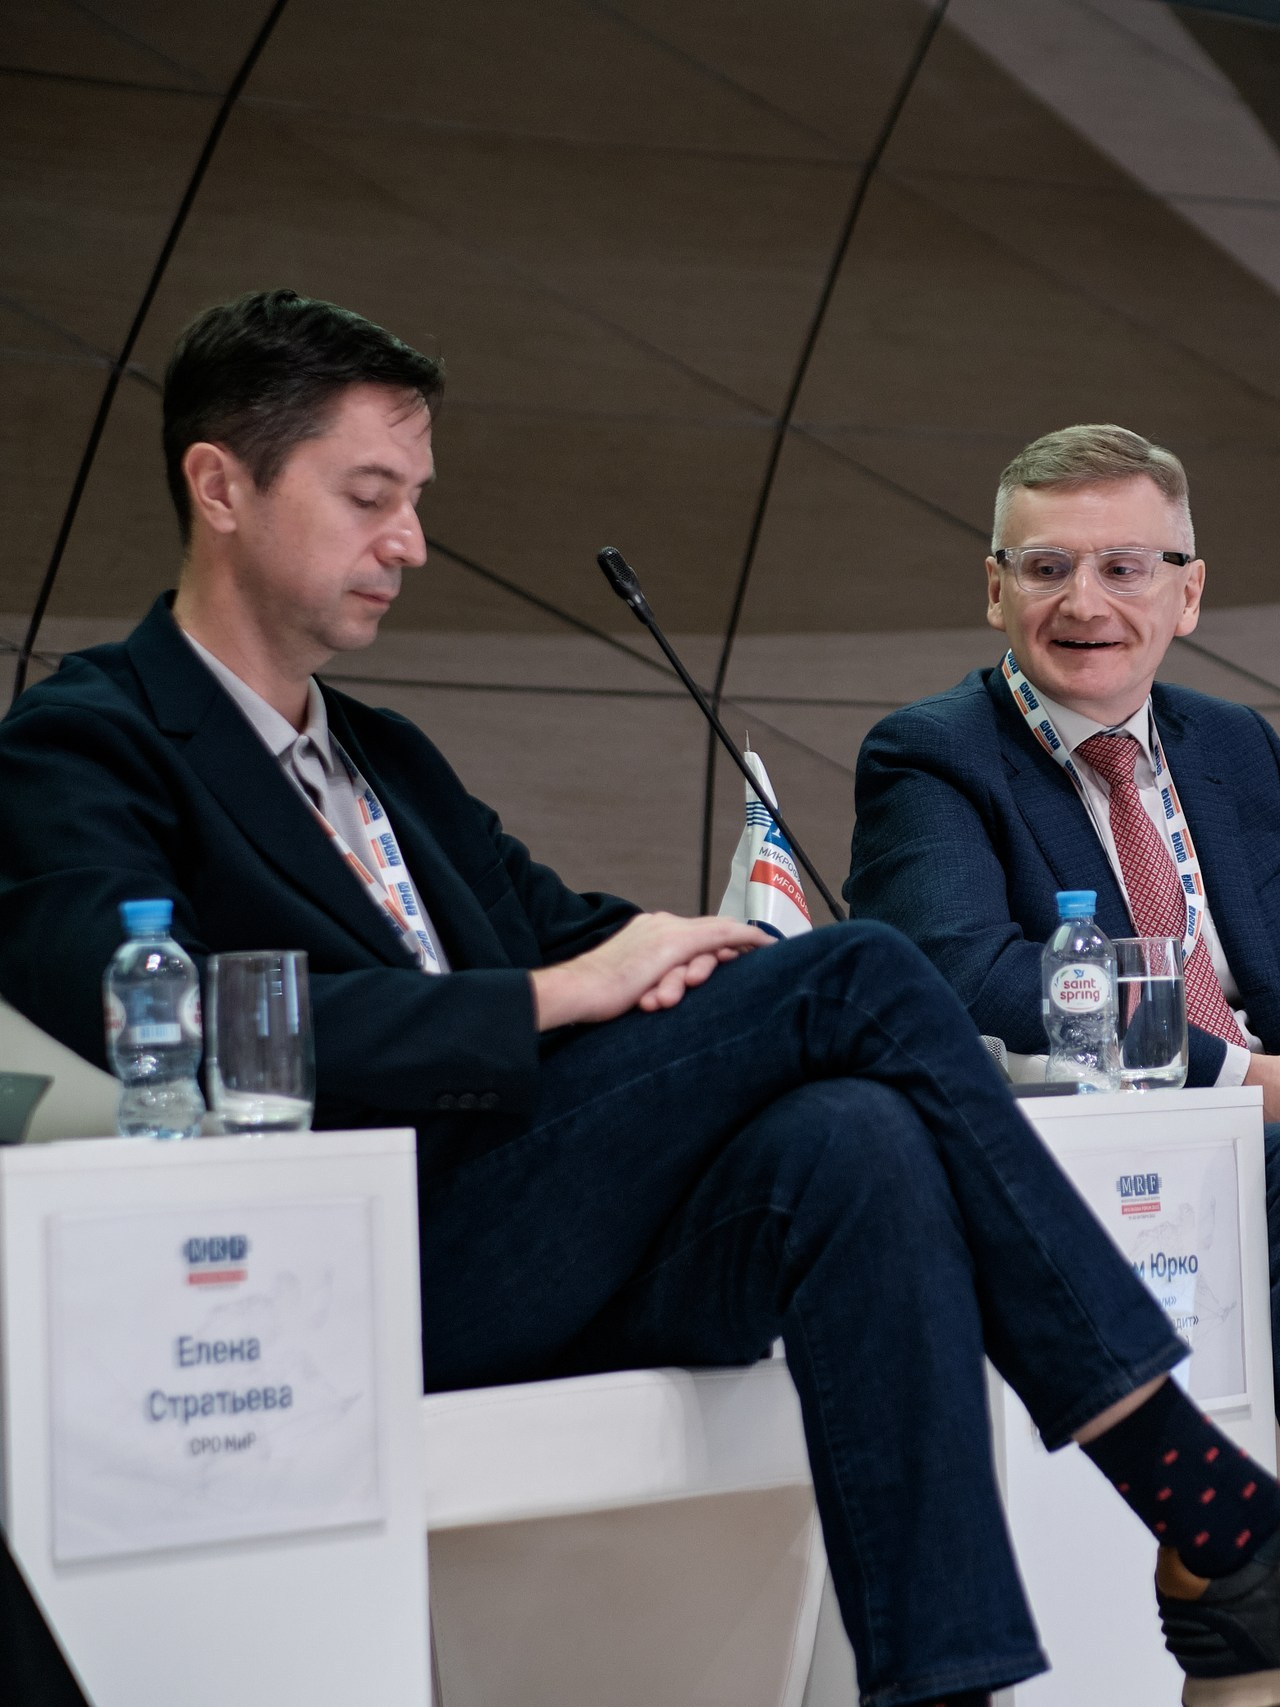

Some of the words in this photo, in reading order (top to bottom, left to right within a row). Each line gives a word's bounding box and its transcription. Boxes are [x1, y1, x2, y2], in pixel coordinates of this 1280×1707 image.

[1020, 682, 1039, 711] MRF
[1040, 720, 1061, 751] MRF
[1161, 787, 1175, 820] MRF
[1171, 832, 1187, 863] MRF
[759, 846, 800, 882] МИКРОФ
[773, 874, 795, 894] MFO
[1060, 990, 1100, 1003] spring
[1063, 978, 1097, 990] saint
[1120, 1173, 1160, 1197] MRF
[1150, 1252, 1199, 1283] Юрко
[176, 1335, 261, 1367] Елена
[147, 1385, 294, 1424] Стратьева
